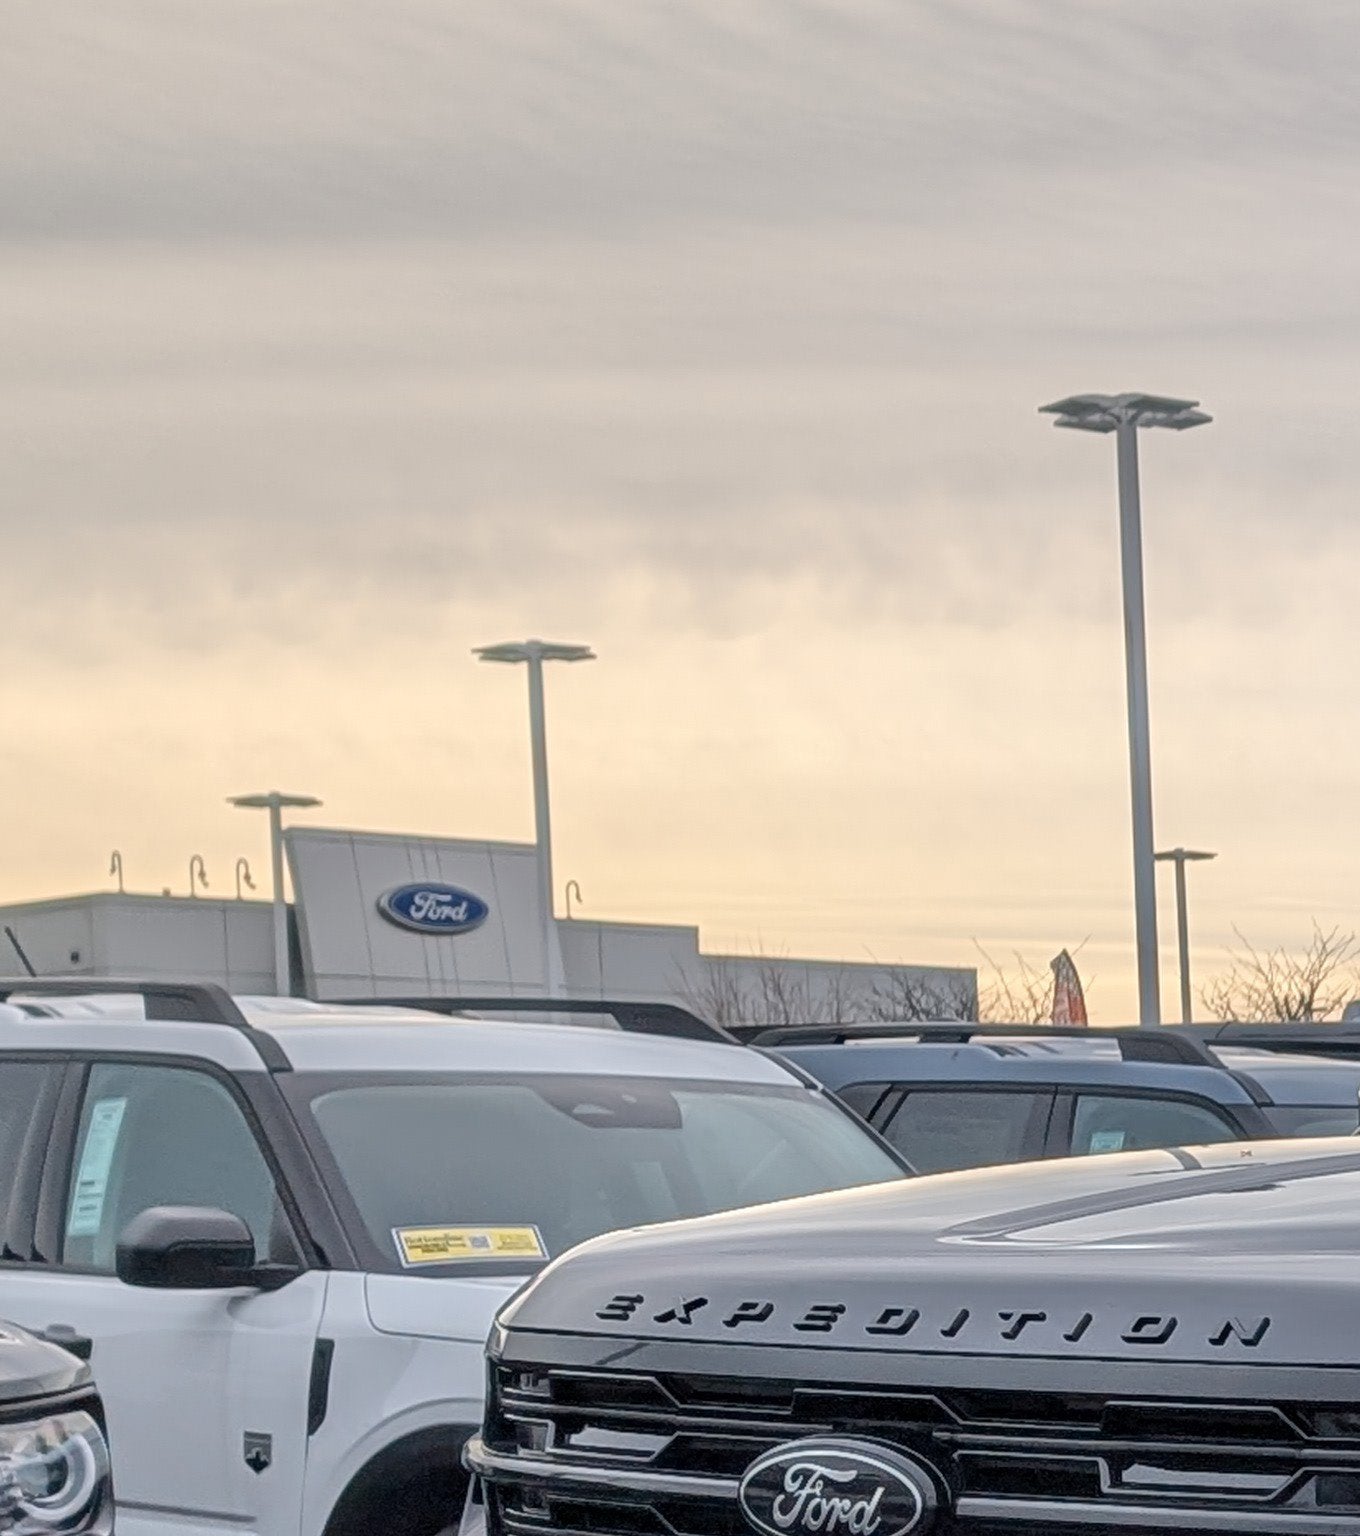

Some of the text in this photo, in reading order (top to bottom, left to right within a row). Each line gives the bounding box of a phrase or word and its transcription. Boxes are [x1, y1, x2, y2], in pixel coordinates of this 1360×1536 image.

[409, 891, 468, 921] Ford
[595, 1293, 1271, 1347] EXPEDITION
[772, 1462, 883, 1536] Ford
